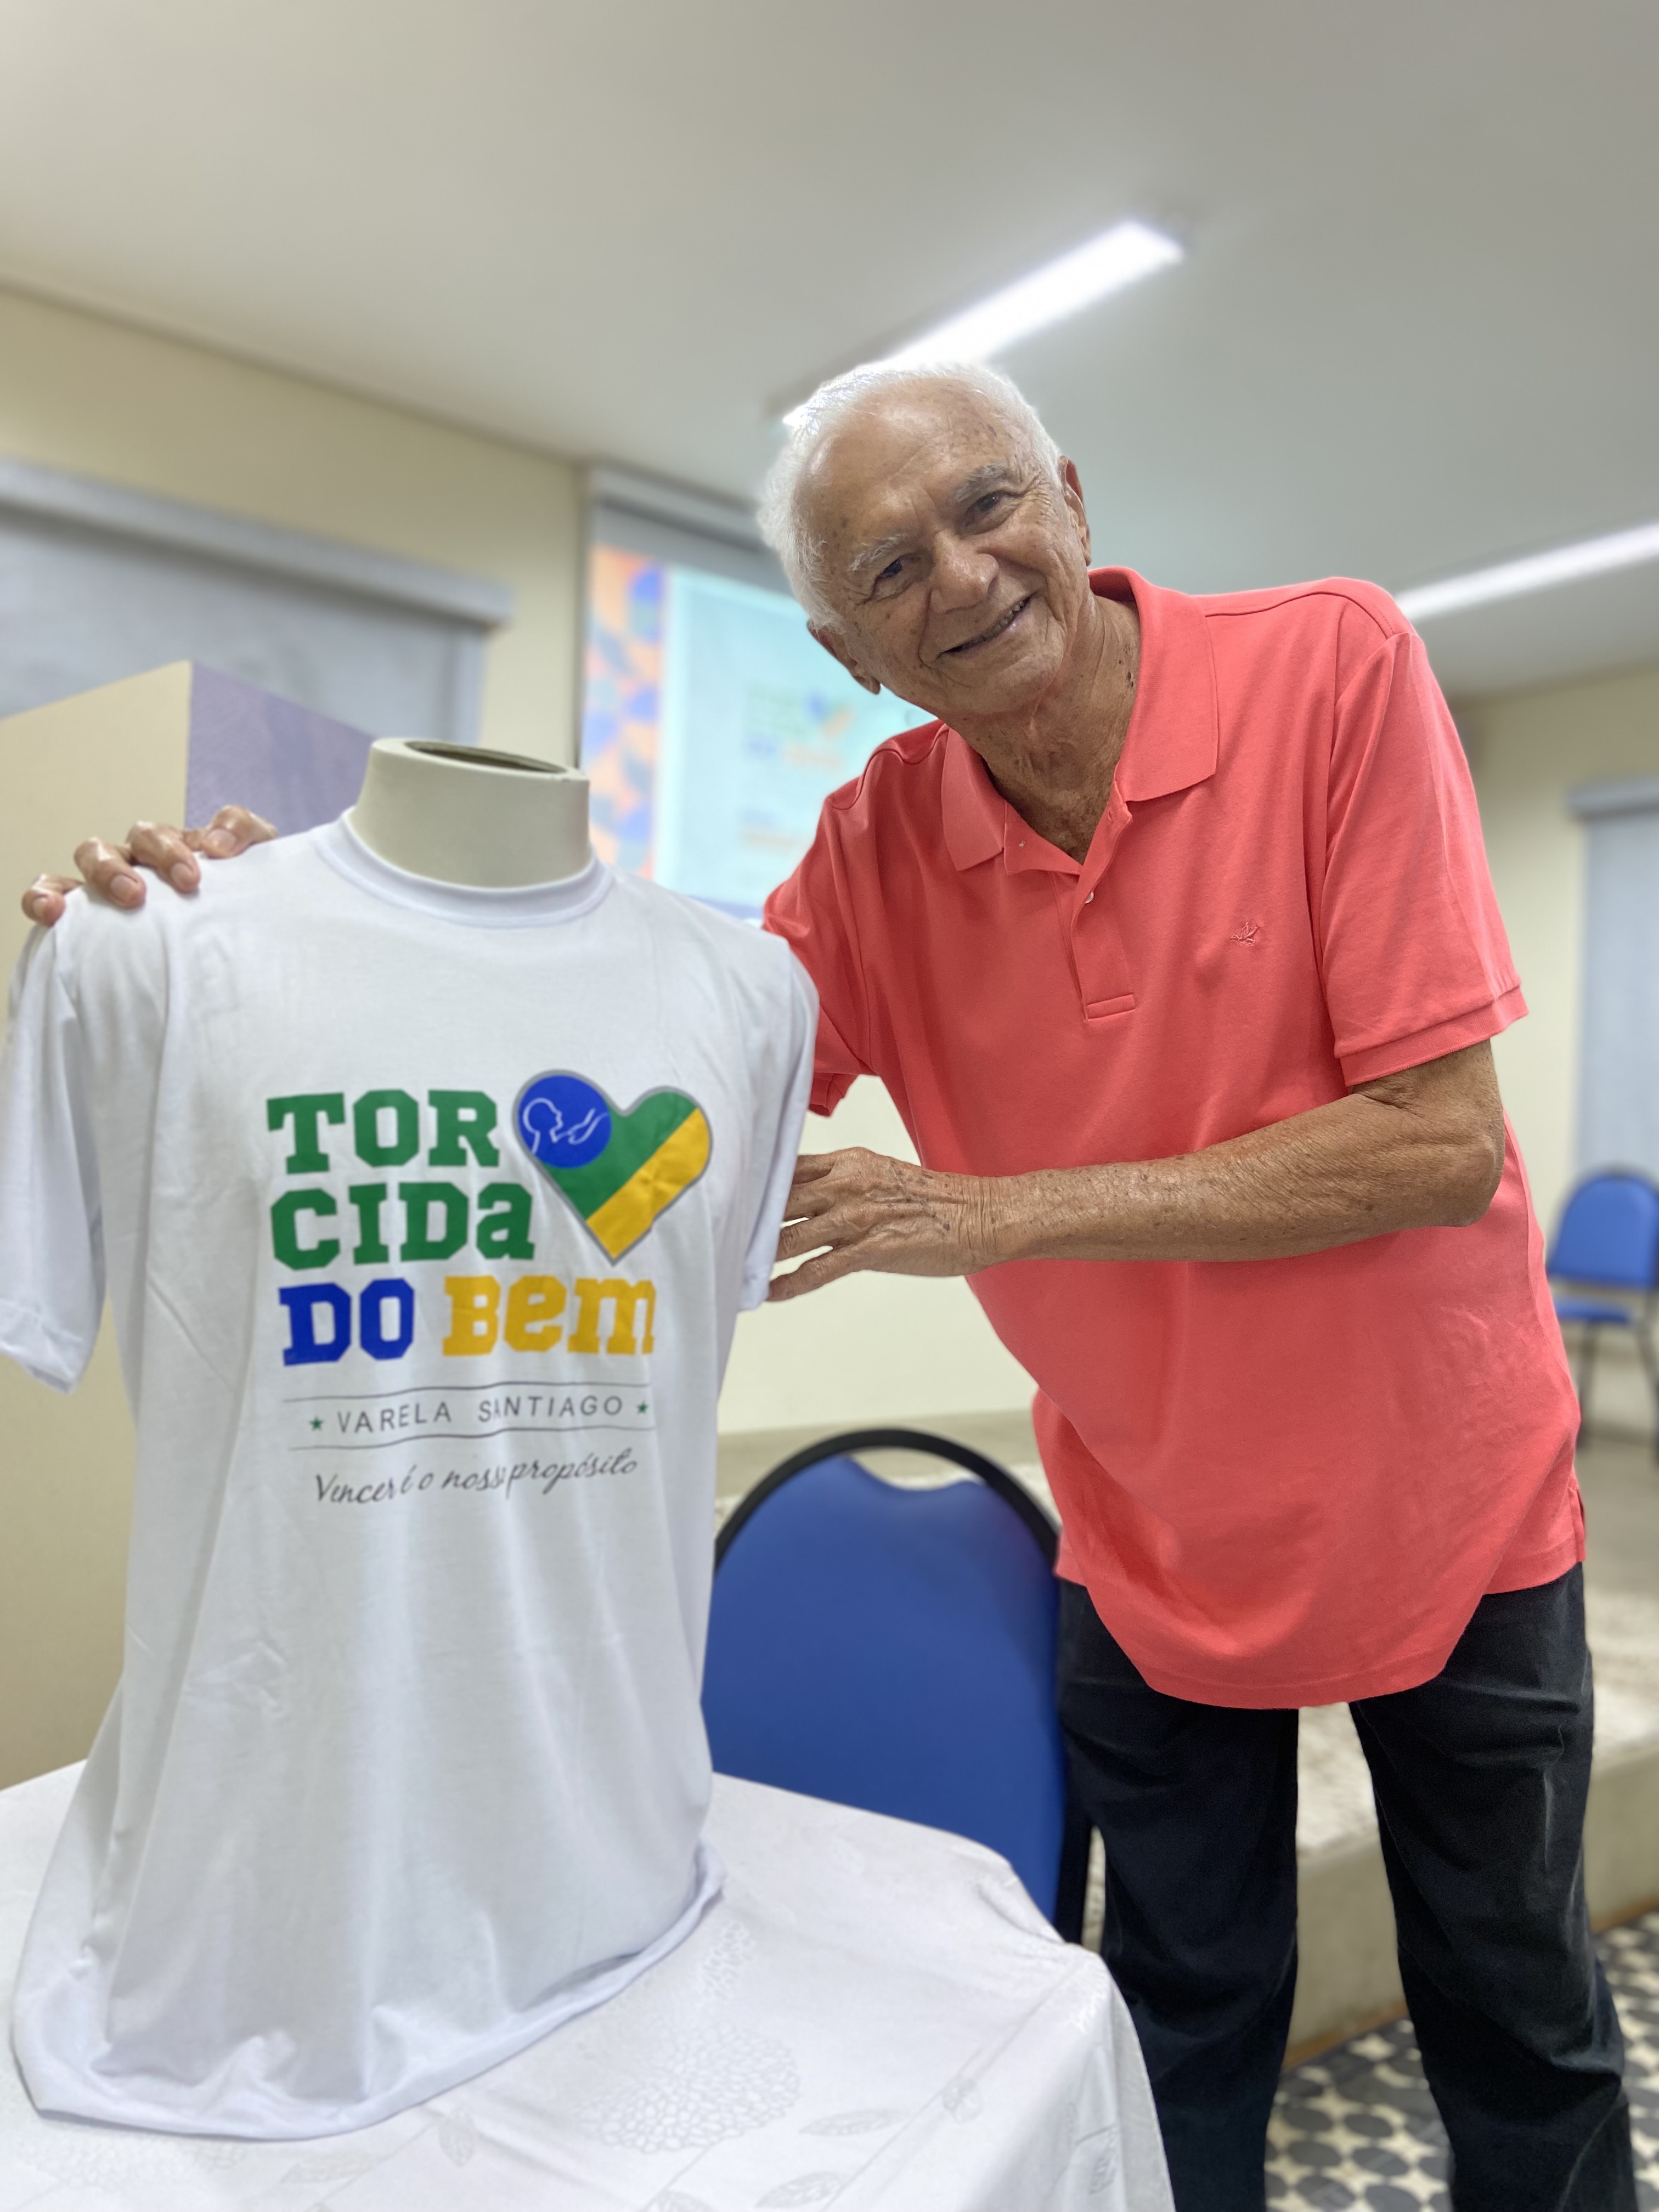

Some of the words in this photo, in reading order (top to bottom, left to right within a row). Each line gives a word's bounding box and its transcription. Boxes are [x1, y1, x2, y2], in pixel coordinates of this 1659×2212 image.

[267, 1090, 500, 1175] TOR
[278, 1278, 415, 1367] DO
[336, 1401, 452, 1434] VARELA
[417, 1472, 434, 1491] o
[505, 1447, 637, 1500] propósito
